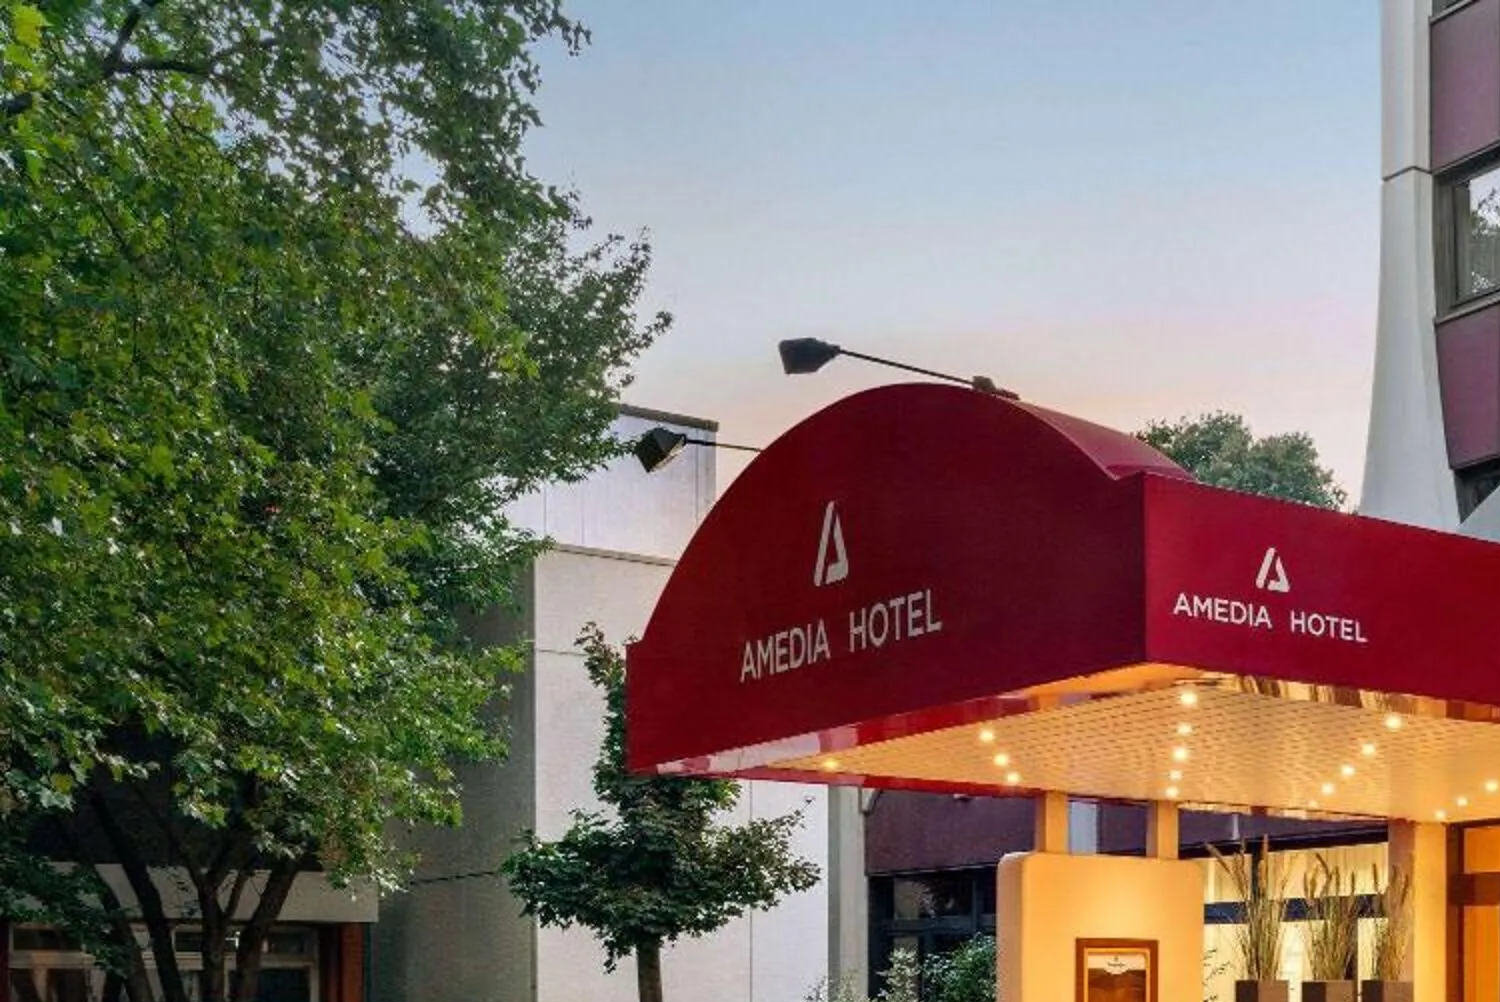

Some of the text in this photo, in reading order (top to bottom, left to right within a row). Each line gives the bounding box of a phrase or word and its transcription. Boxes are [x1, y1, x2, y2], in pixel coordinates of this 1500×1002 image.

[740, 588, 943, 683] AMEDIA HOTEL
[1173, 592, 1369, 643] AMEDIA HOTEL
